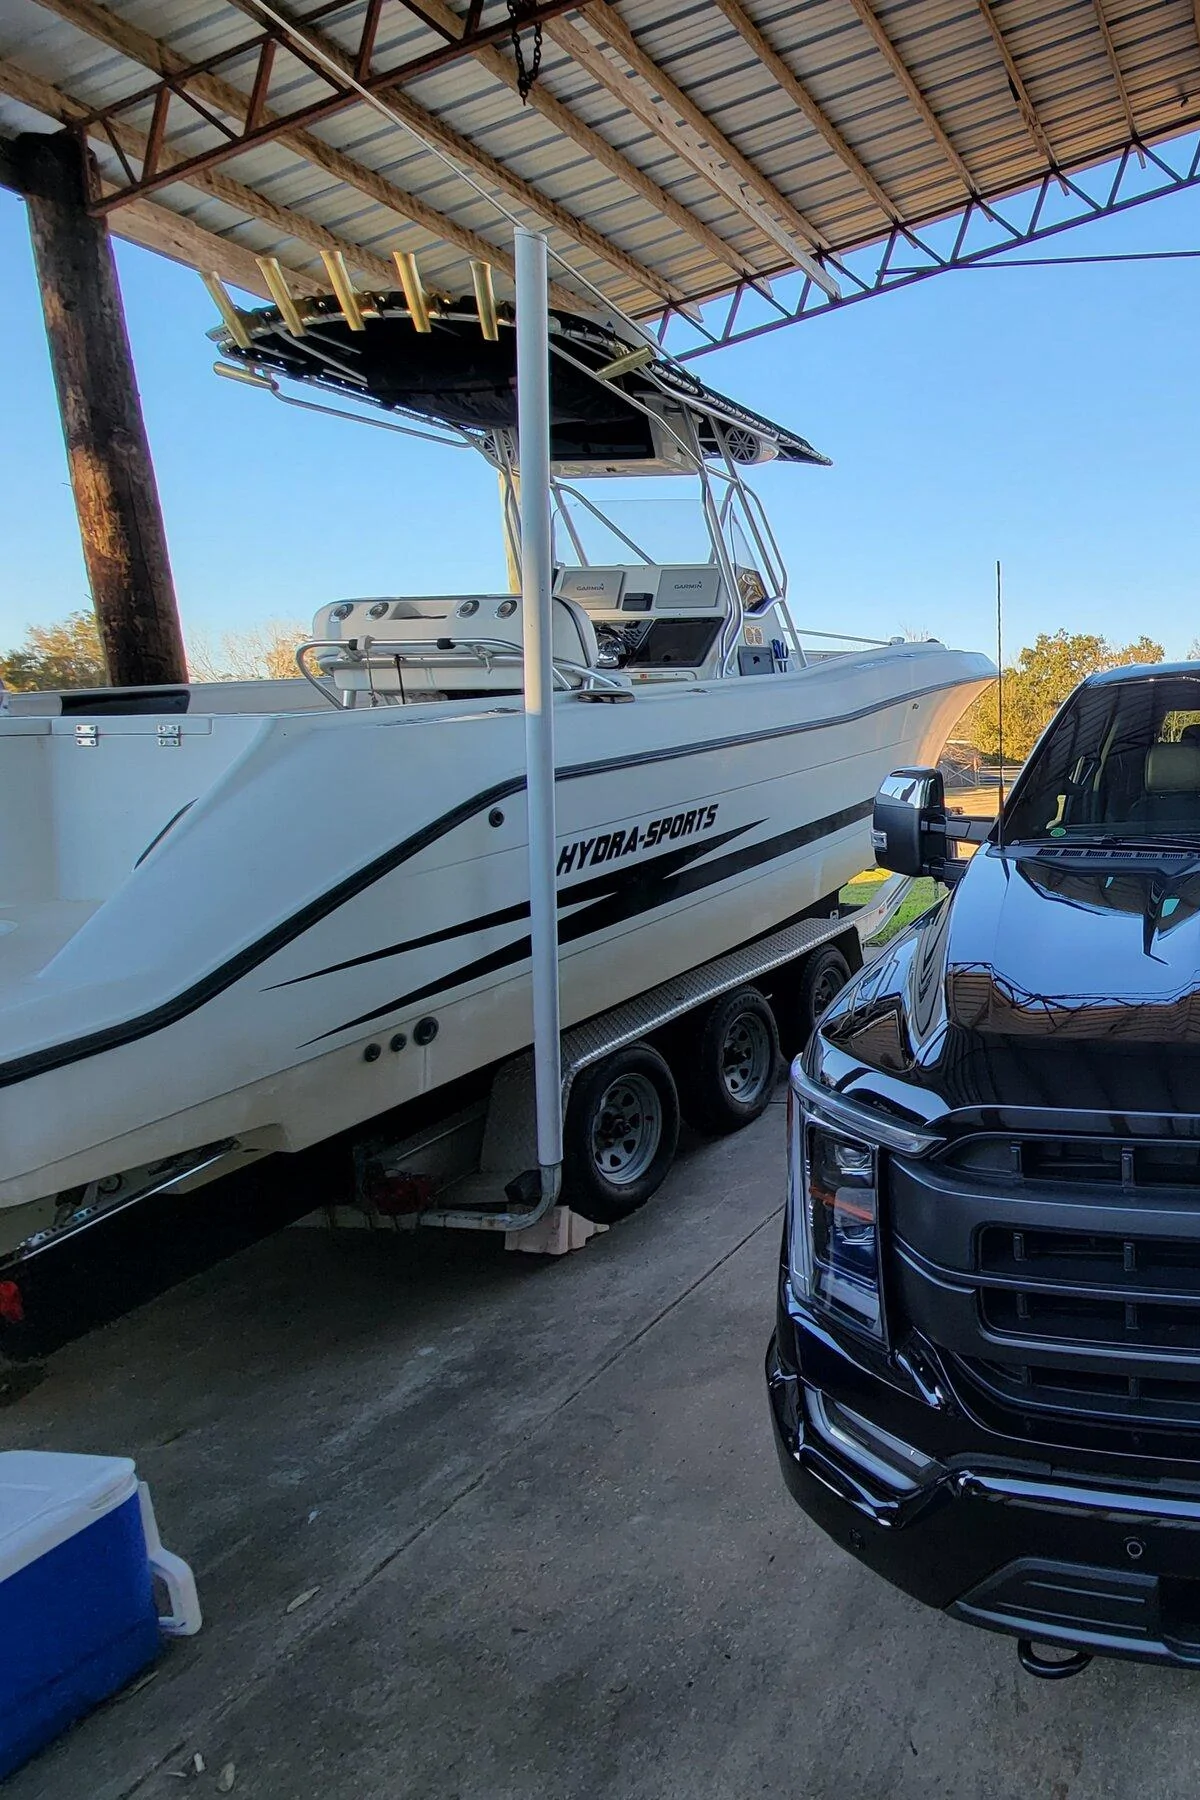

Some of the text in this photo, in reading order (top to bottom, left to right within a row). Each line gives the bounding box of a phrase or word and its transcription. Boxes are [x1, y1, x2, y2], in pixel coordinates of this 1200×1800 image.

[576, 582, 605, 591] GARMIN
[674, 580, 703, 590] GARMIN
[556, 803, 719, 877] HYDRA-SPORTS
